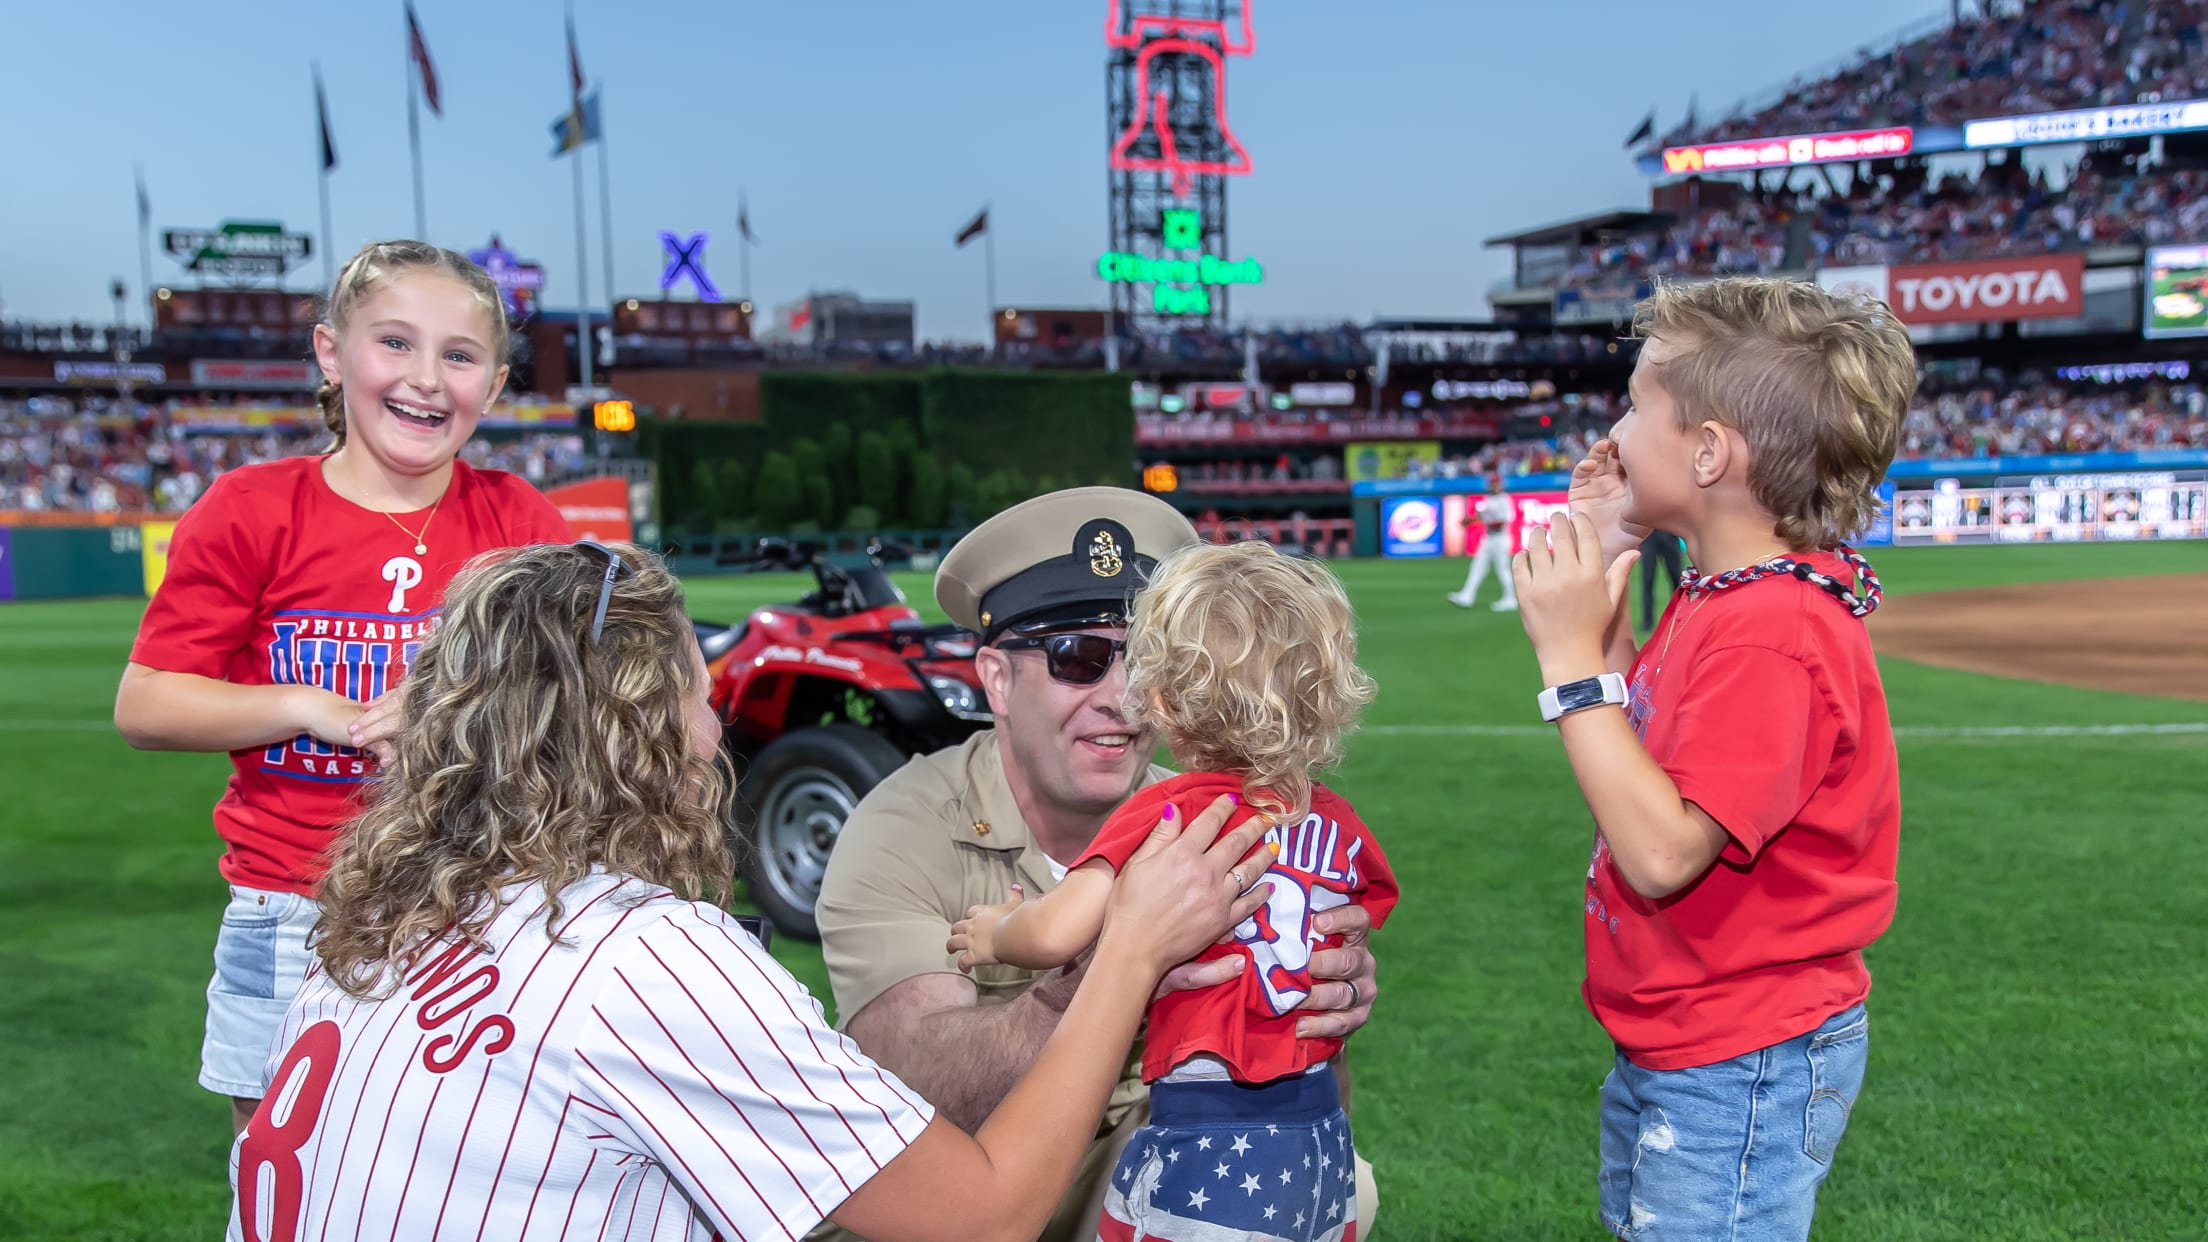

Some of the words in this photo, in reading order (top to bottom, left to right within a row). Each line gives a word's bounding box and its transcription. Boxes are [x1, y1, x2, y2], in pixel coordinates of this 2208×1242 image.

[1895, 268, 2069, 312] TOYOTA
[382, 556, 423, 613] P
[302, 758, 382, 776] BAS
